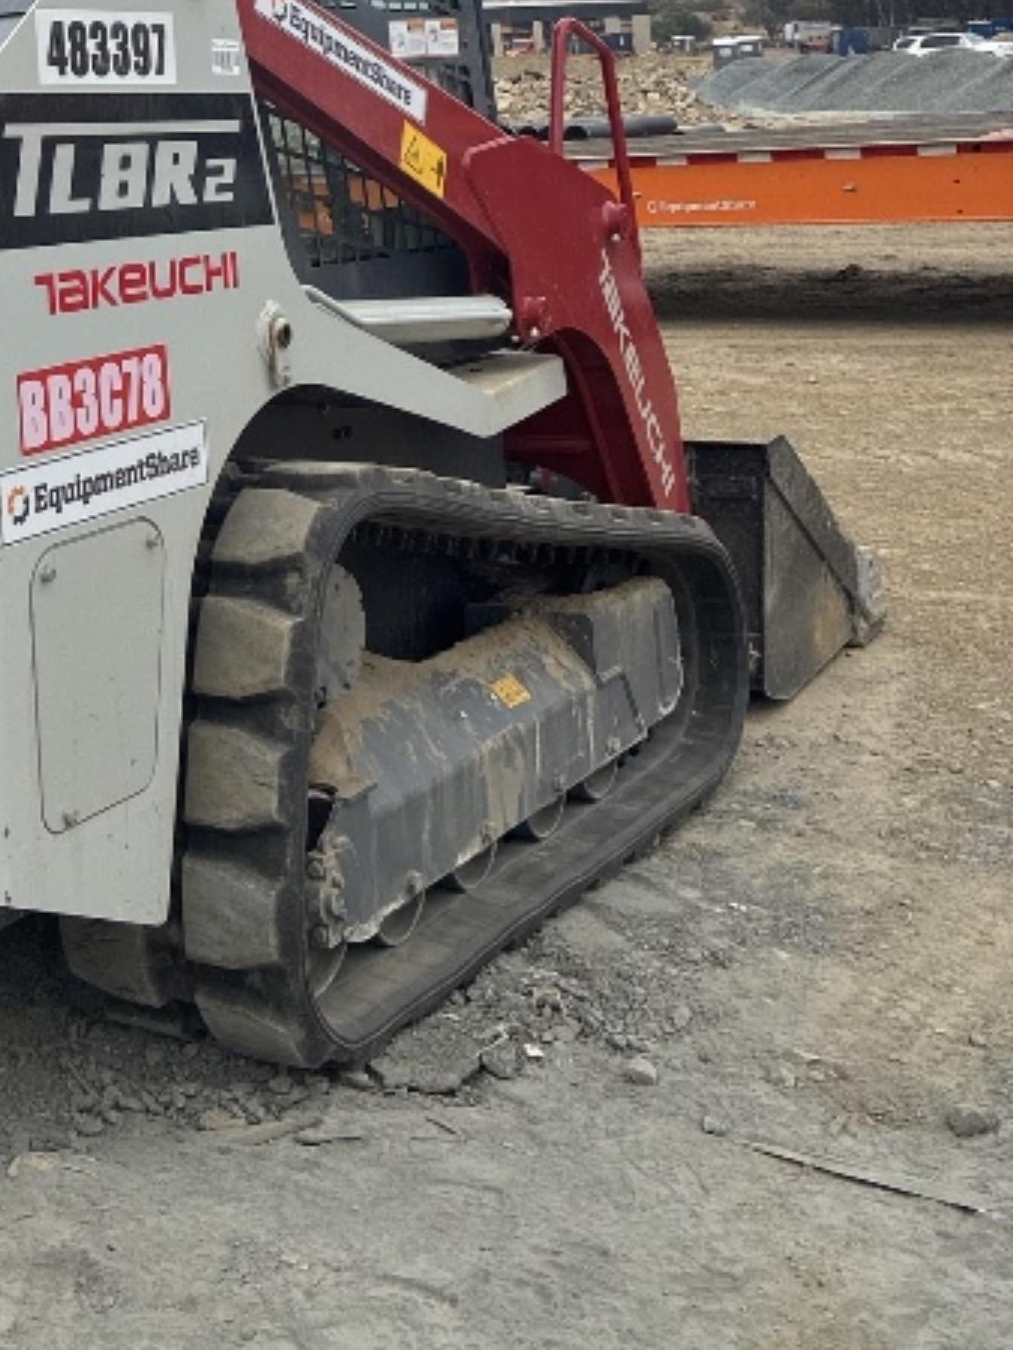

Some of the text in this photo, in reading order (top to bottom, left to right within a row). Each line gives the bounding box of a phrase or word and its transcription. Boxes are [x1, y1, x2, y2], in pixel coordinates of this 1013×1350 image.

[47, 21, 165, 77] 483397
[19, 353, 165, 449] BB3C78
[34, 447, 201, 513] EquipmentShare
